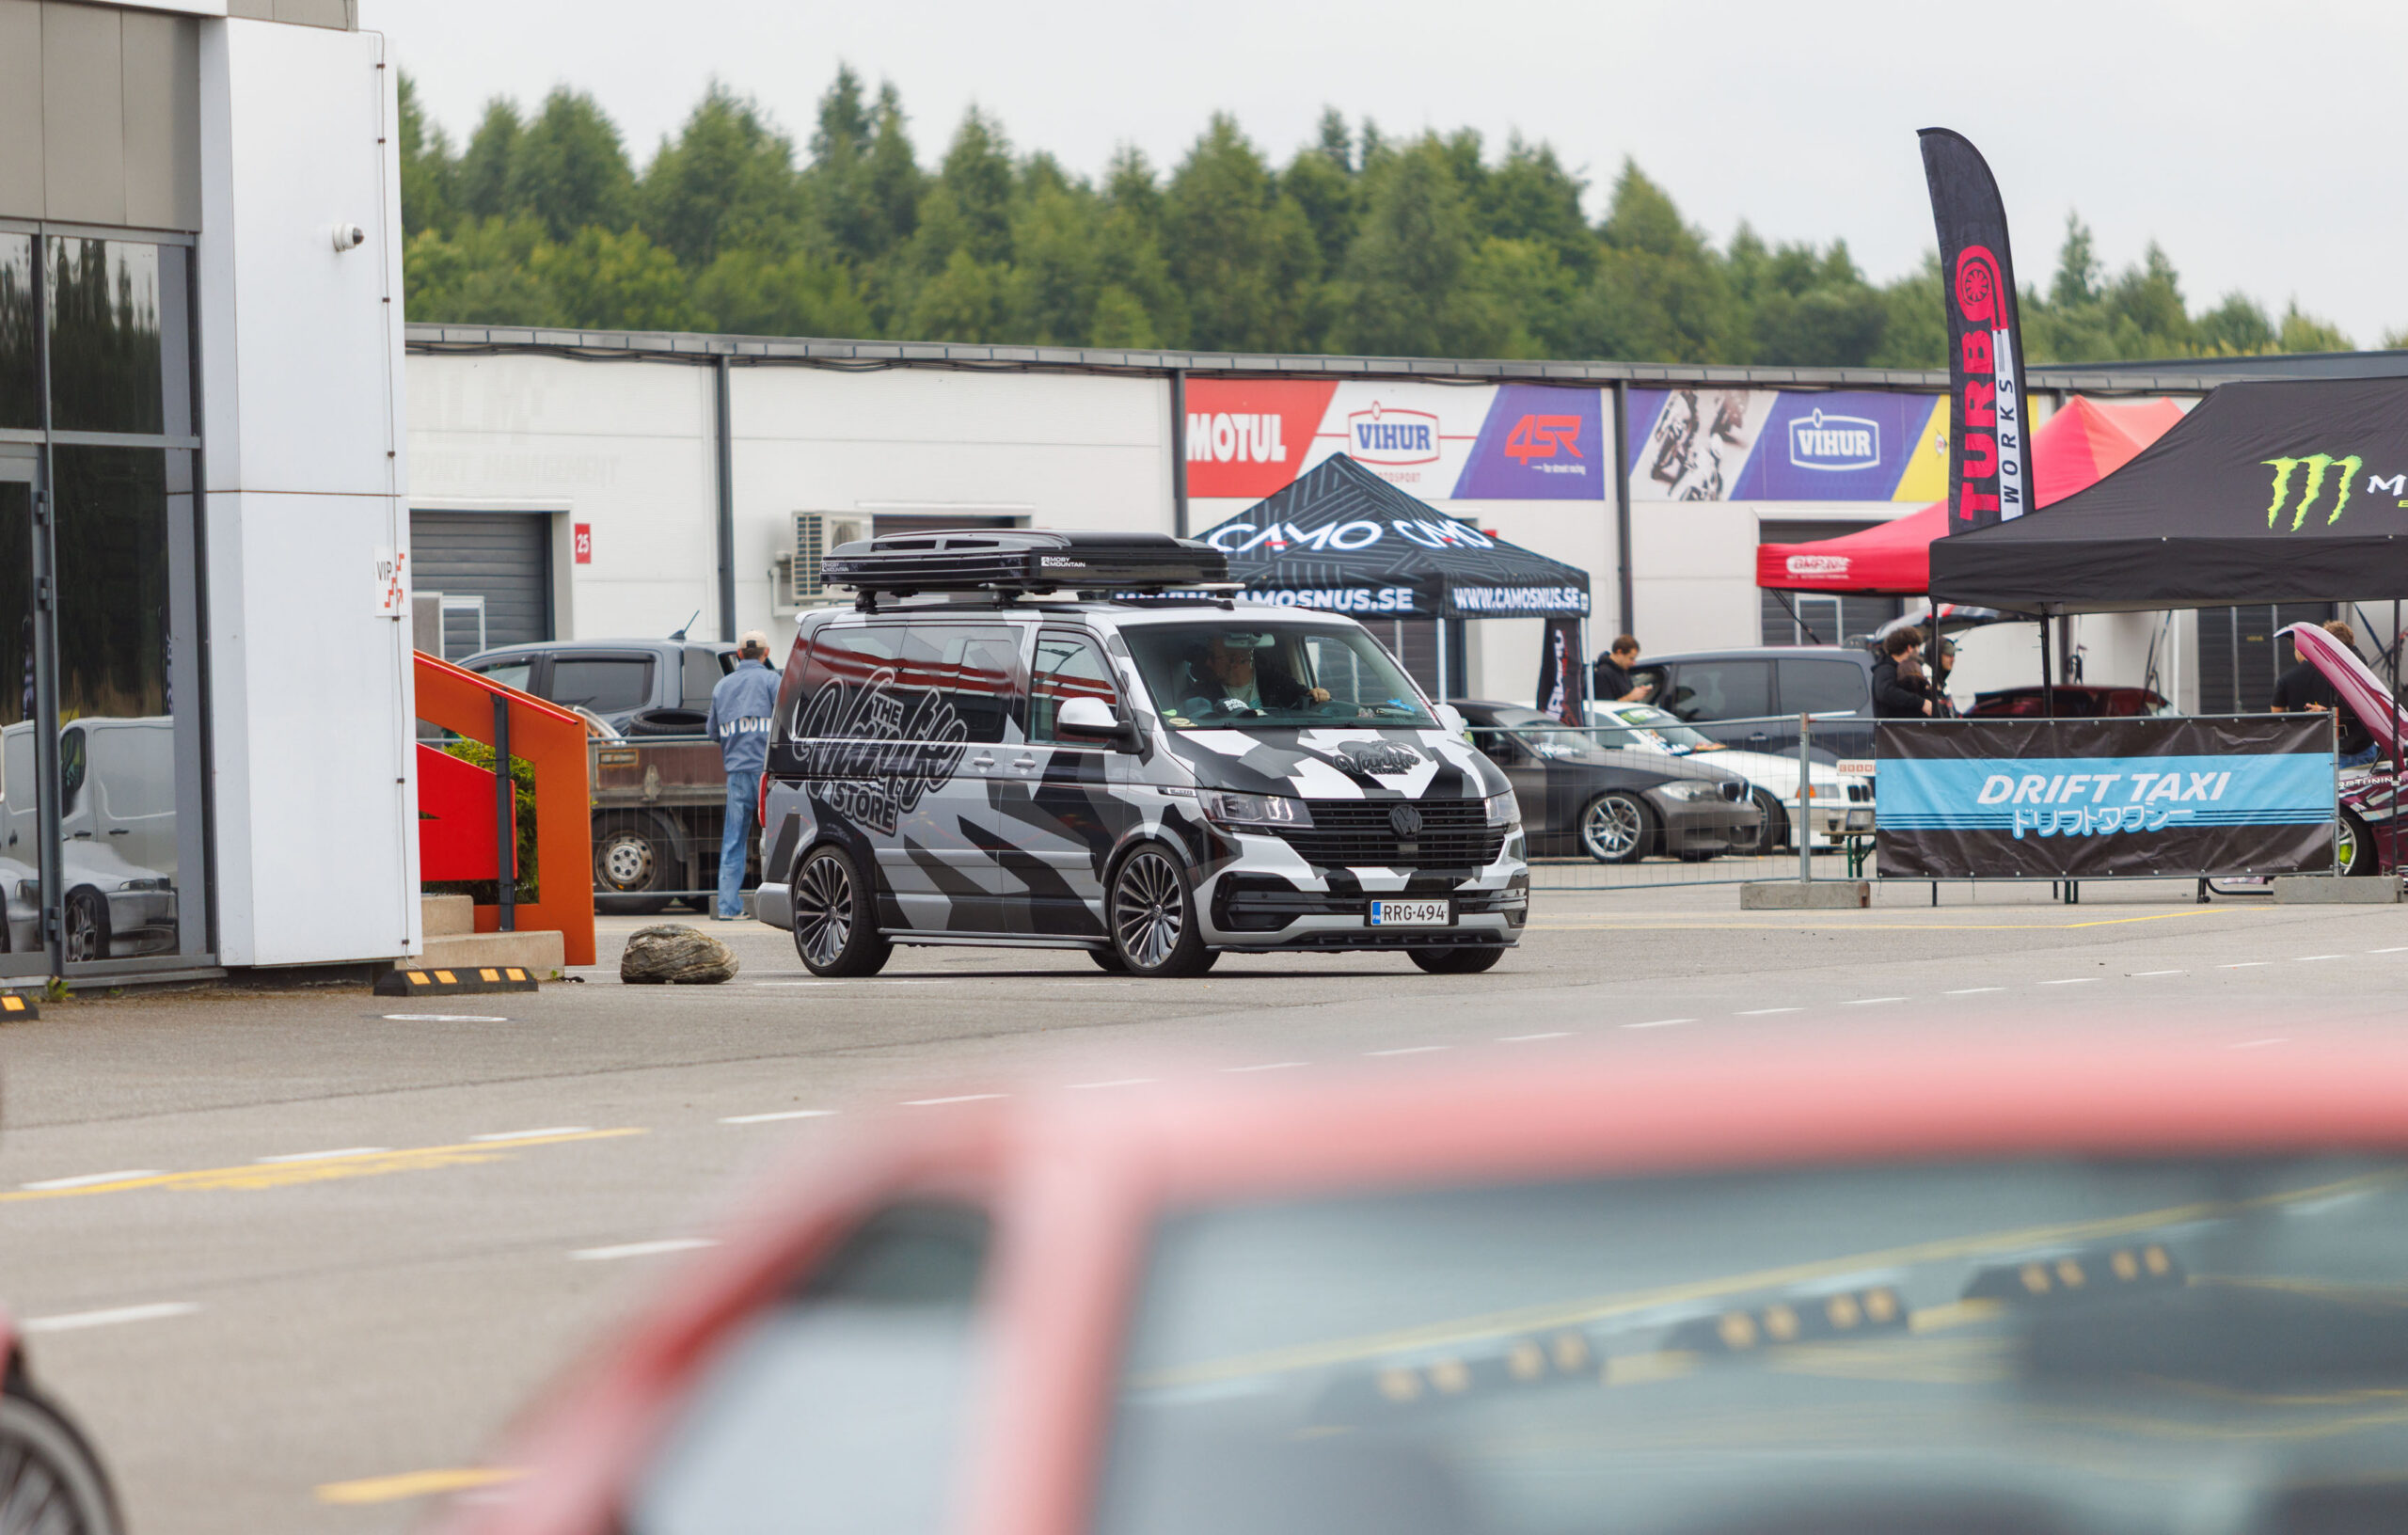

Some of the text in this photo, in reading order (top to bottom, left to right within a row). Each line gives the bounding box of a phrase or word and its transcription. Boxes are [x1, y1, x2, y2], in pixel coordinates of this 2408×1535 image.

[1186, 413, 1286, 463] MOTUL
[1356, 423, 1431, 451] VIHUR
[1505, 414, 1584, 466] 4SR
[1798, 430, 1871, 456] VIHUR
[2000, 378, 2020, 504] WORKS
[577, 534, 590, 553] 25
[1207, 520, 1383, 553] CAMO
[1391, 520, 1495, 548] CAMO
[376, 562, 391, 580] VIP
[1453, 588, 1580, 609] WWW.CAMOSNUS.SE
[872, 692, 904, 731] THE
[1977, 772, 2231, 803] DRIFT TAXI
[832, 782, 898, 837] STORE
[1384, 905, 1445, 921] RRG-494
